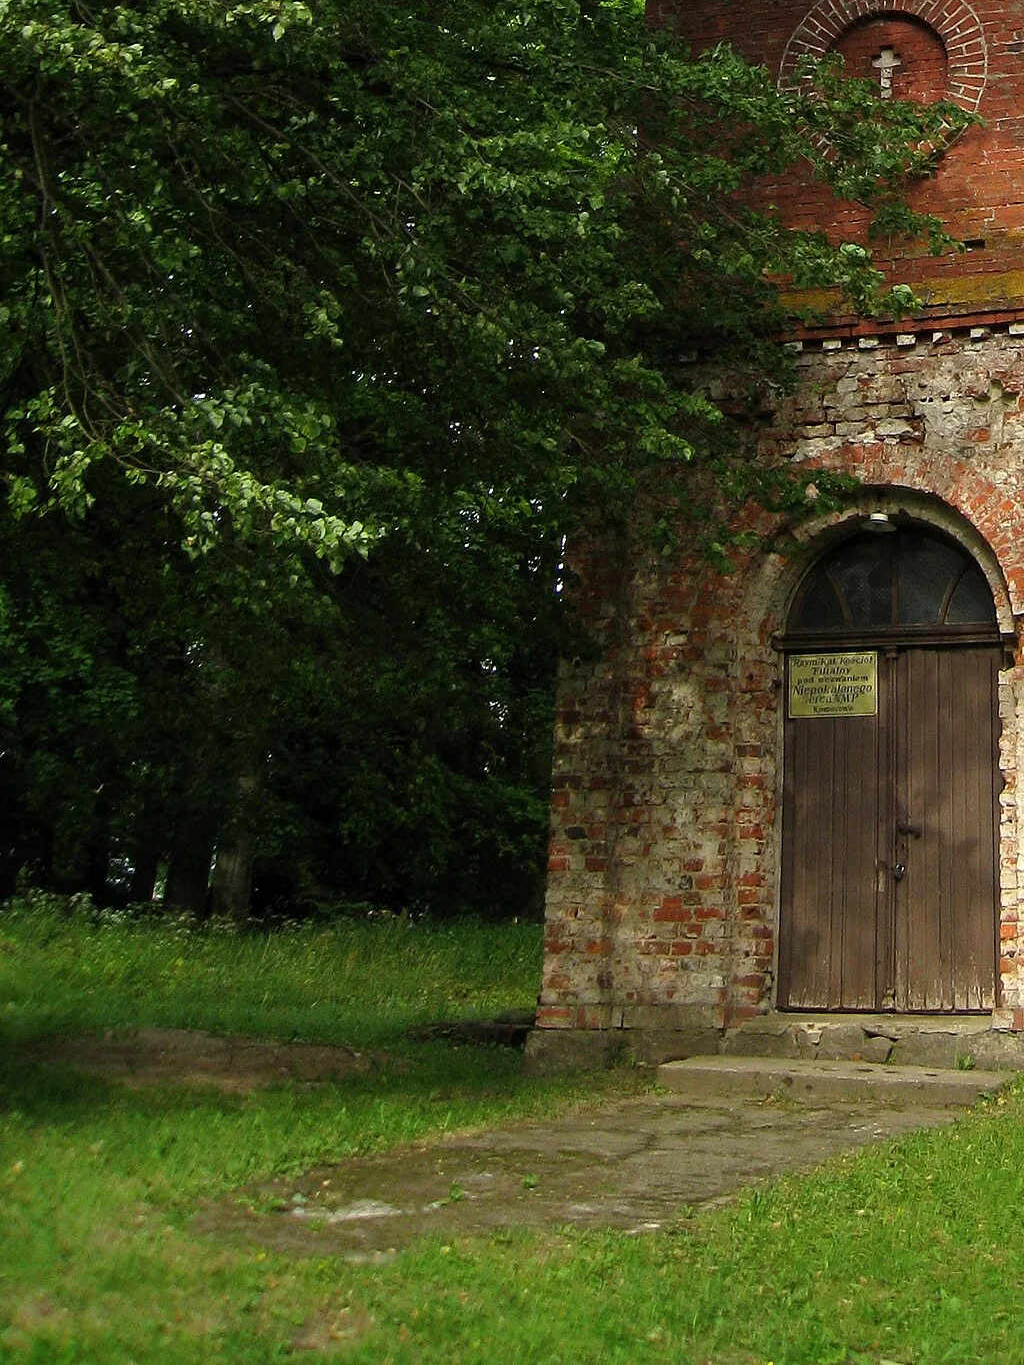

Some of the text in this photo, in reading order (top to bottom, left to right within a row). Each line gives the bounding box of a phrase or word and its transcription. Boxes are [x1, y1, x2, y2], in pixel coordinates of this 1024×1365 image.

[797, 675, 869, 685] pod wezwaniem
[793, 684, 872, 696] Niepokalanego
